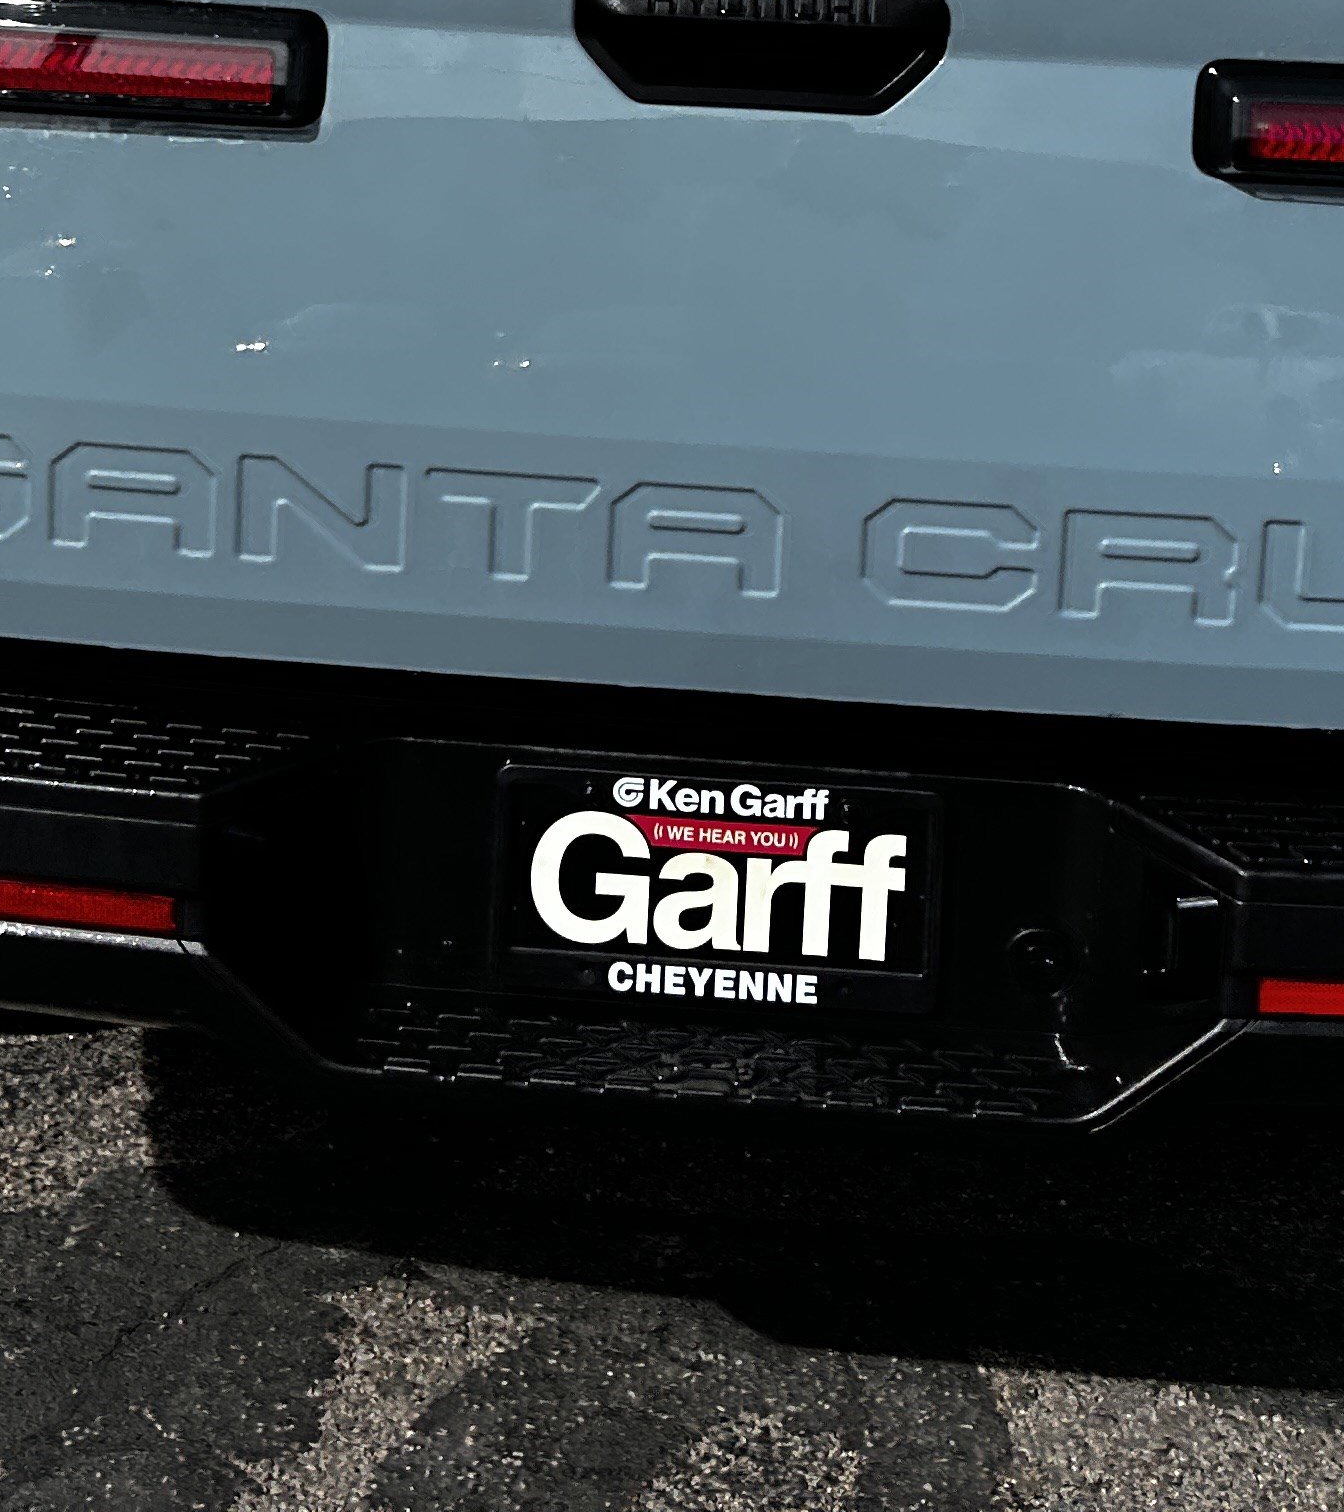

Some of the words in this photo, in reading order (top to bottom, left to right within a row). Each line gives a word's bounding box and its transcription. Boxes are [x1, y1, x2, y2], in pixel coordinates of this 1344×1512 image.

[648, 778, 725, 815] Ken
[730, 784, 830, 821] Garff
[667, 825, 695, 842] WE
[698, 828, 747, 846] HEAR
[750, 832, 786, 848] YOU
[530, 810, 907, 962] Garff
[607, 961, 818, 1005] CHEYENNE
